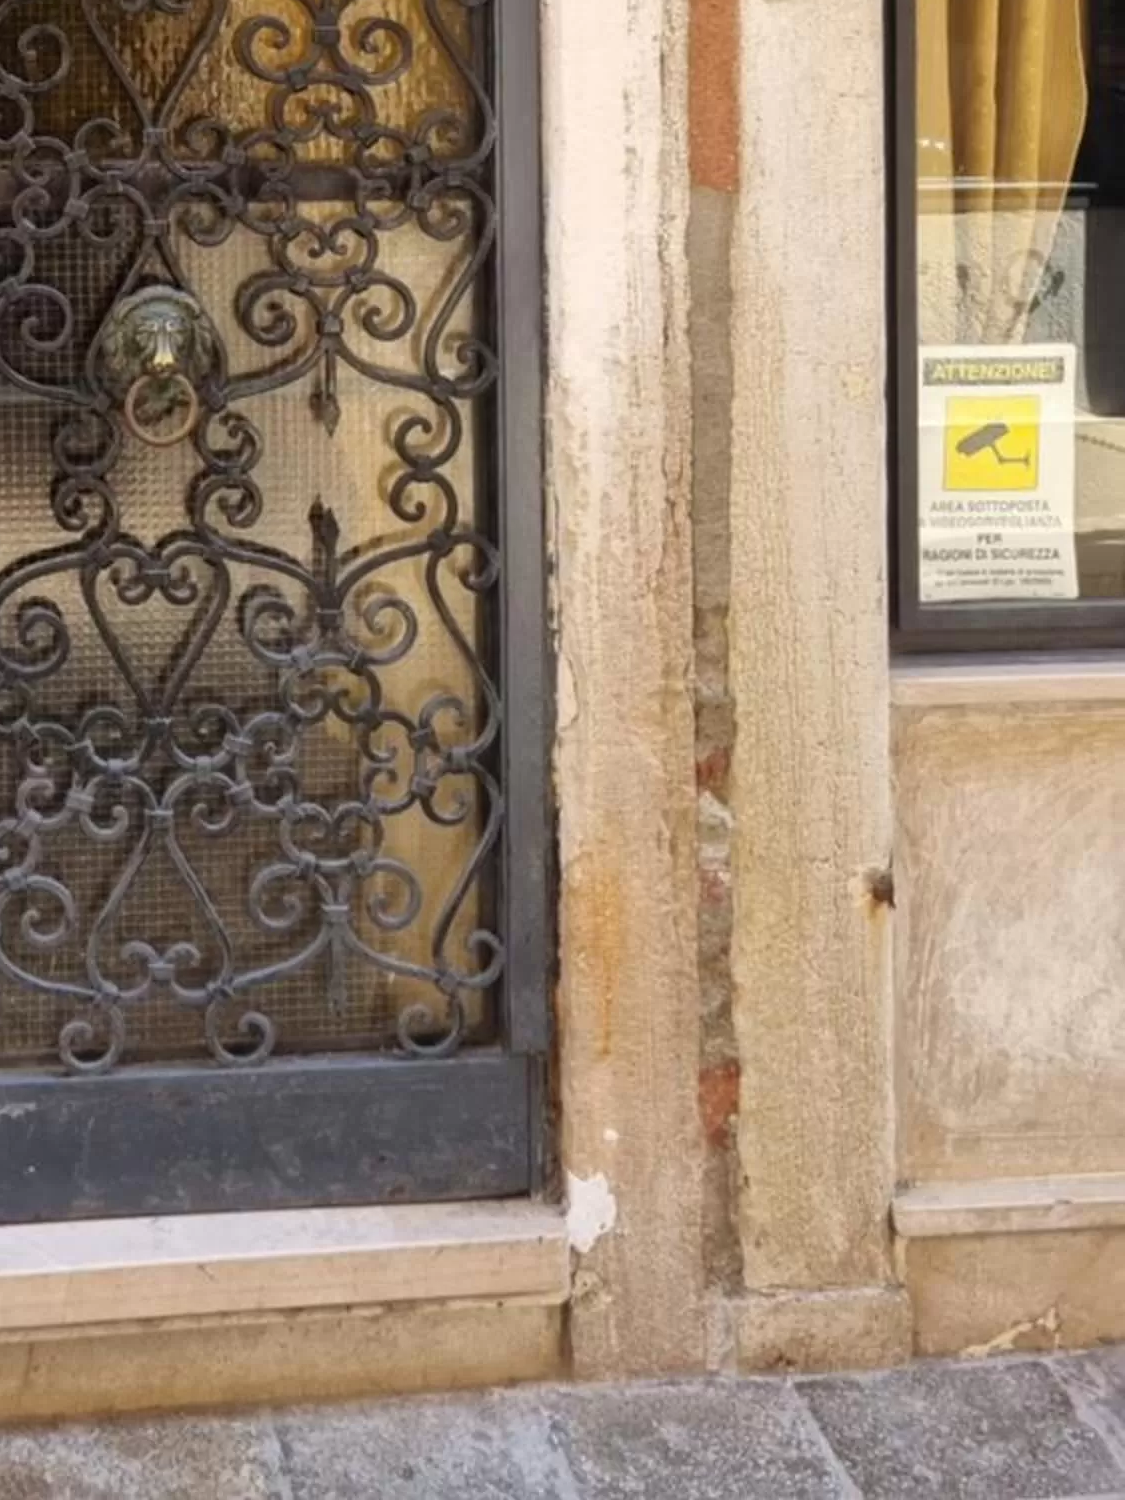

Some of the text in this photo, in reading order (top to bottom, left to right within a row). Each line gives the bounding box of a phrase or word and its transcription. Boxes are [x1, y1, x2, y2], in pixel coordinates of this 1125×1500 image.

[967, 500, 1050, 512] SOTTOPOSTA
[977, 534, 1002, 544] PER
[923, 548, 1060, 561] RAGIONI DI SICUREZZA
